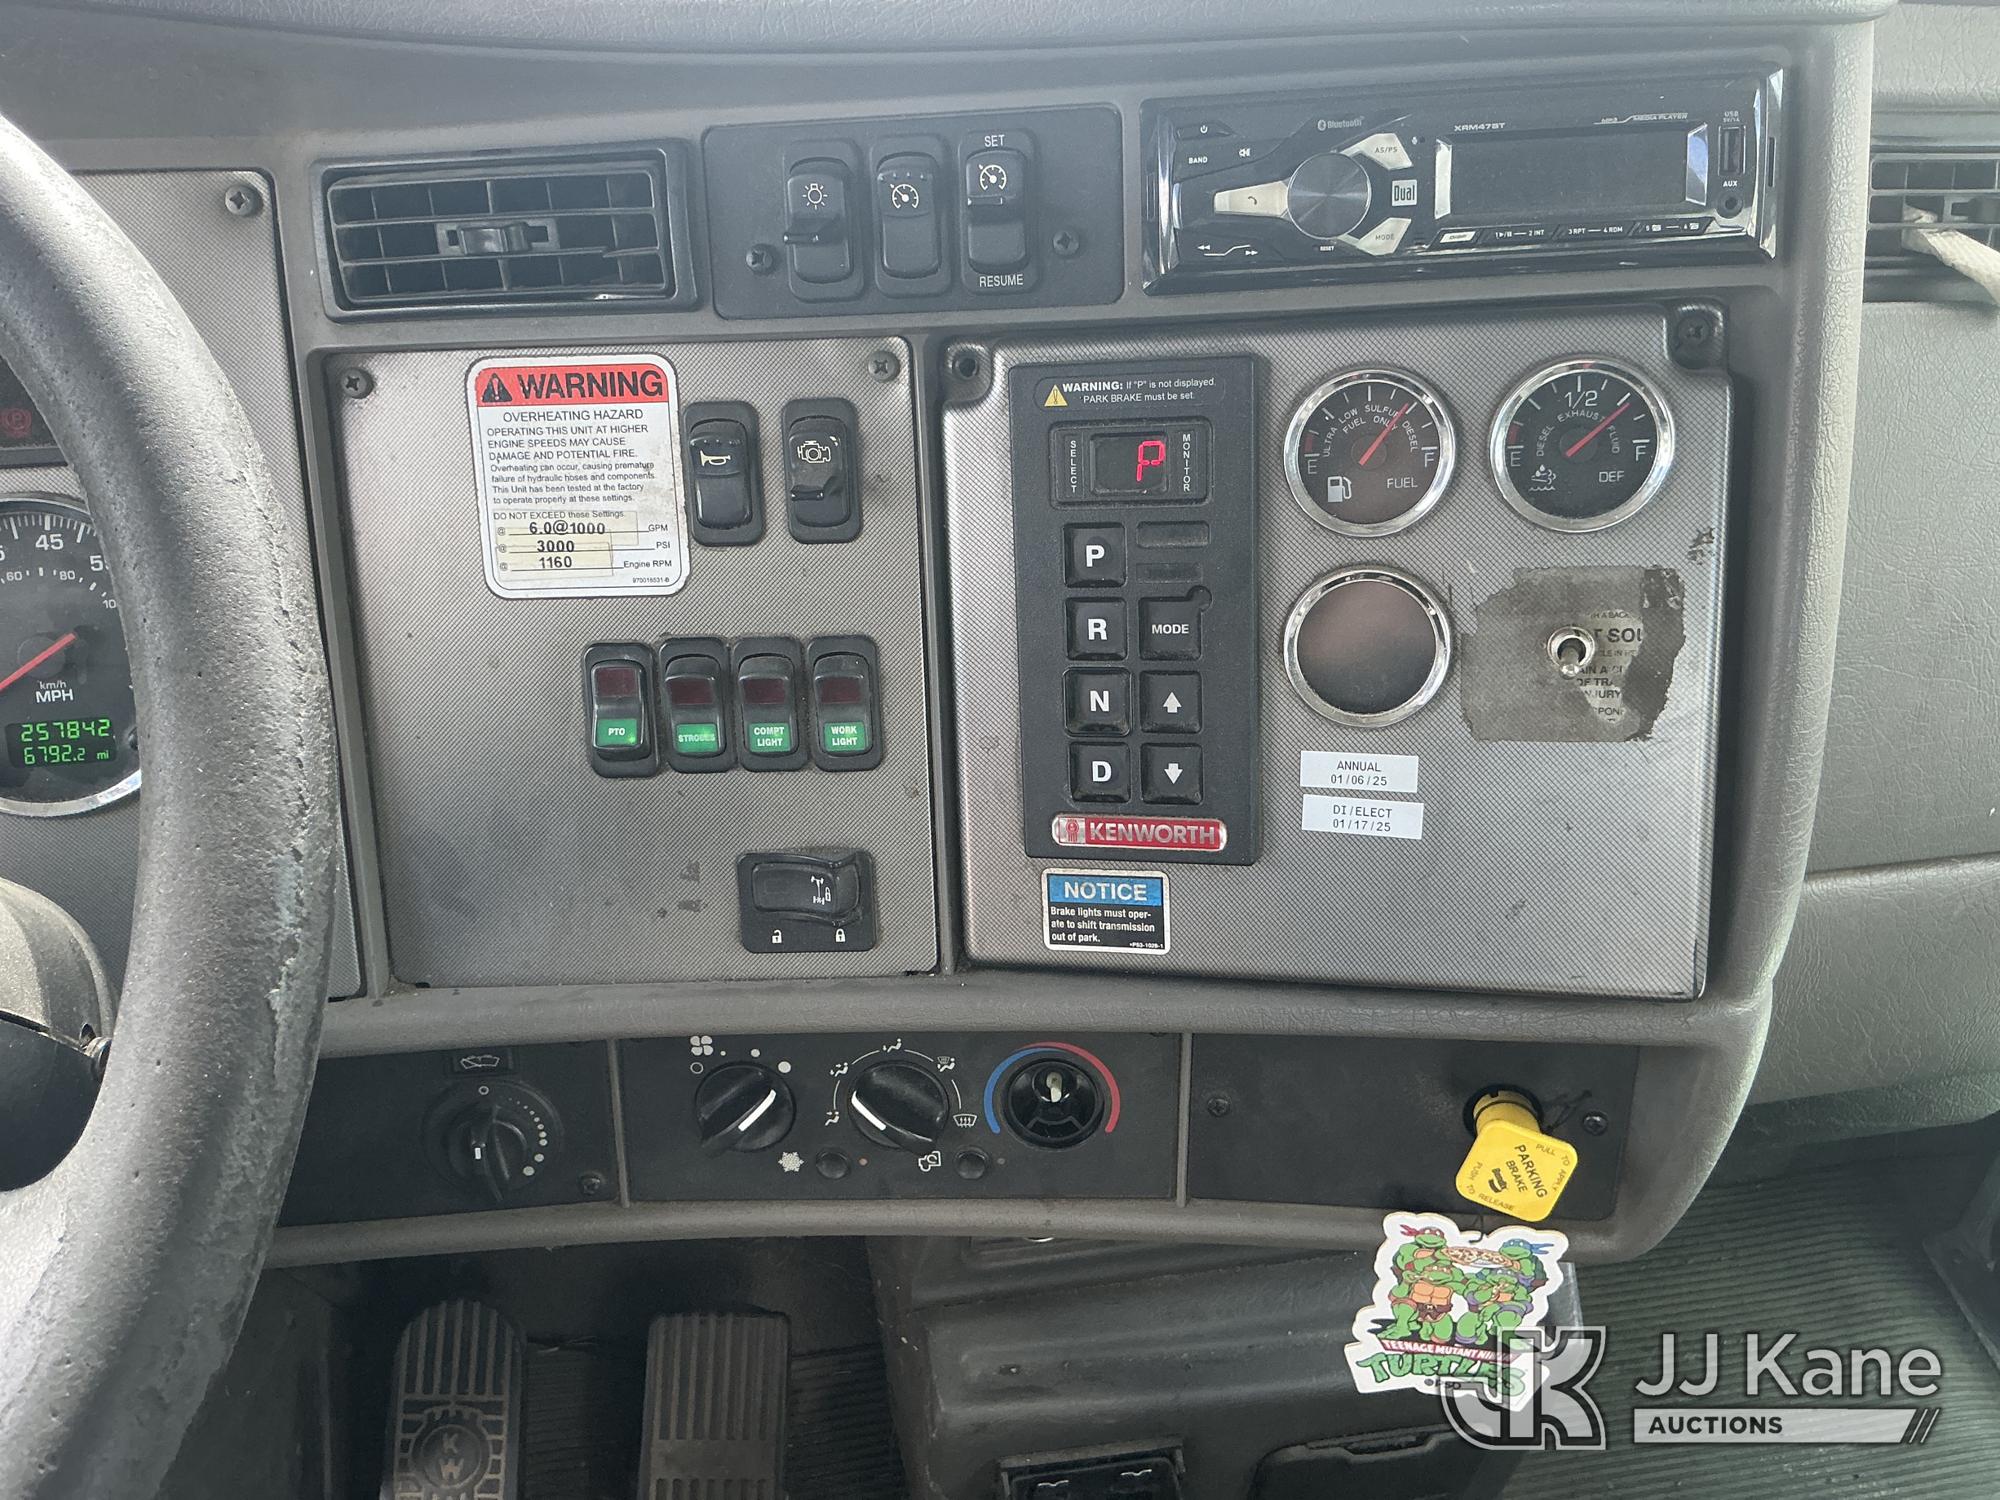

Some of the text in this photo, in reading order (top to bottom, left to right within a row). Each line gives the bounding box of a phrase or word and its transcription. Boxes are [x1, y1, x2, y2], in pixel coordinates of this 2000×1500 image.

[984, 135, 1005, 147] SET
[1189, 156, 1207, 164] BAND
[1394, 185, 1415, 201] Dual
[979, 274, 1024, 287] RESUME
[517, 371, 663, 399] WARNING
[1063, 381, 1123, 392] WARNING:
[1126, 381, 1132, 389] If
[1133, 380, 1147, 389] "P"
[1149, 380, 1156, 388] is
[1158, 379, 1172, 388] not
[1083, 394, 1109, 404] PARK
[1111, 393, 1142, 402] BRAKE
[1144, 392, 1165, 401] must
[1167, 391, 1177, 400] be
[1564, 390, 1598, 409] 1/2
[503, 409, 643, 422] OVERHEATING HAZARD
[487, 425, 648, 436] OPERATING THIS UNIT AT HIGHER
[1342, 416, 1366, 434] FUEL
[1323, 426, 1338, 457] ULTRA
[1338, 408, 1358, 424] LOW
[1402, 420, 1418, 452] DIESEL
[488, 437, 626, 448] ENGINE SPEEDS MAY CAUSE
[1536, 425, 1555, 457] DIESEL
[1607, 425, 1619, 453] FLUID
[489, 449, 637, 460] DAMAGE AND POTENTIAL FIRE.
[1511, 452, 1521, 467] E
[1636, 445, 1646, 461] F
[1136, 440, 1166, 481] P
[1182, 434, 1191, 492] MONITOR
[1425, 452, 1434, 468] F
[491, 464, 538, 472] Overheating
[583, 462, 612, 472] causing
[1308, 460, 1317, 474] E
[492, 475, 516, 483] failure
[527, 474, 563, 483] hydraulic
[1387, 477, 1418, 489] FUEL
[1599, 471, 1625, 482] DEF
[511, 485, 527, 493] Unit
[546, 484, 565, 492] been
[568, 483, 591, 491] tested
[618, 482, 644, 492] factory
[493, 496, 500, 504] to
[503, 496, 533, 505] operate
[535, 495, 566, 505] properly
[493, 512, 506, 520] DO
[530, 511, 566, 519] EXCEED
[529, 520, 668, 535] 6.0@1000 GPM
[36, 534, 64, 550] 45
[537, 540, 574, 552] 3000
[539, 556, 572, 568] 1160
[1086, 545, 1105, 568] P
[6, 571, 22, 580] 60
[60, 570, 75, 580] 80
[1088, 618, 1107, 640] R
[1152, 624, 1189, 635] MODE
[40, 680, 66, 689] km/h
[36, 689, 73, 703] MPH
[1090, 690, 1109, 712] N
[21, 719, 110, 742] 257842
[608, 728, 626, 736] PTO
[753, 726, 785, 735] COMPT
[831, 726, 857, 735] WORK
[757, 738, 783, 747] LIGHT
[832, 737, 857, 746] LIGHT
[24, 745, 109, 764] 6792.2 mi
[1092, 761, 1112, 782] D
[1337, 761, 1382, 772] ANNUAL
[1090, 821, 1215, 846] KENWORTH
[1064, 882, 1148, 901] NOTICE
[1050, 907, 1151, 919] Brake lights must oper-
[1078, 921, 1097, 929] shift
[1099, 922, 1155, 932] transmission
[1079, 934, 1100, 943] park.
[1515, 1145, 1547, 1198] PARKING
[1536, 1144, 1570, 1191] PULL TO APPLY
[1506, 1160, 1528, 1192] BRAKE
[1479, 1194, 1514, 1211] RELEASE
[1382, 1340, 1434, 1352] TEENAGE
[1436, 1347, 1479, 1359] MUTANT
